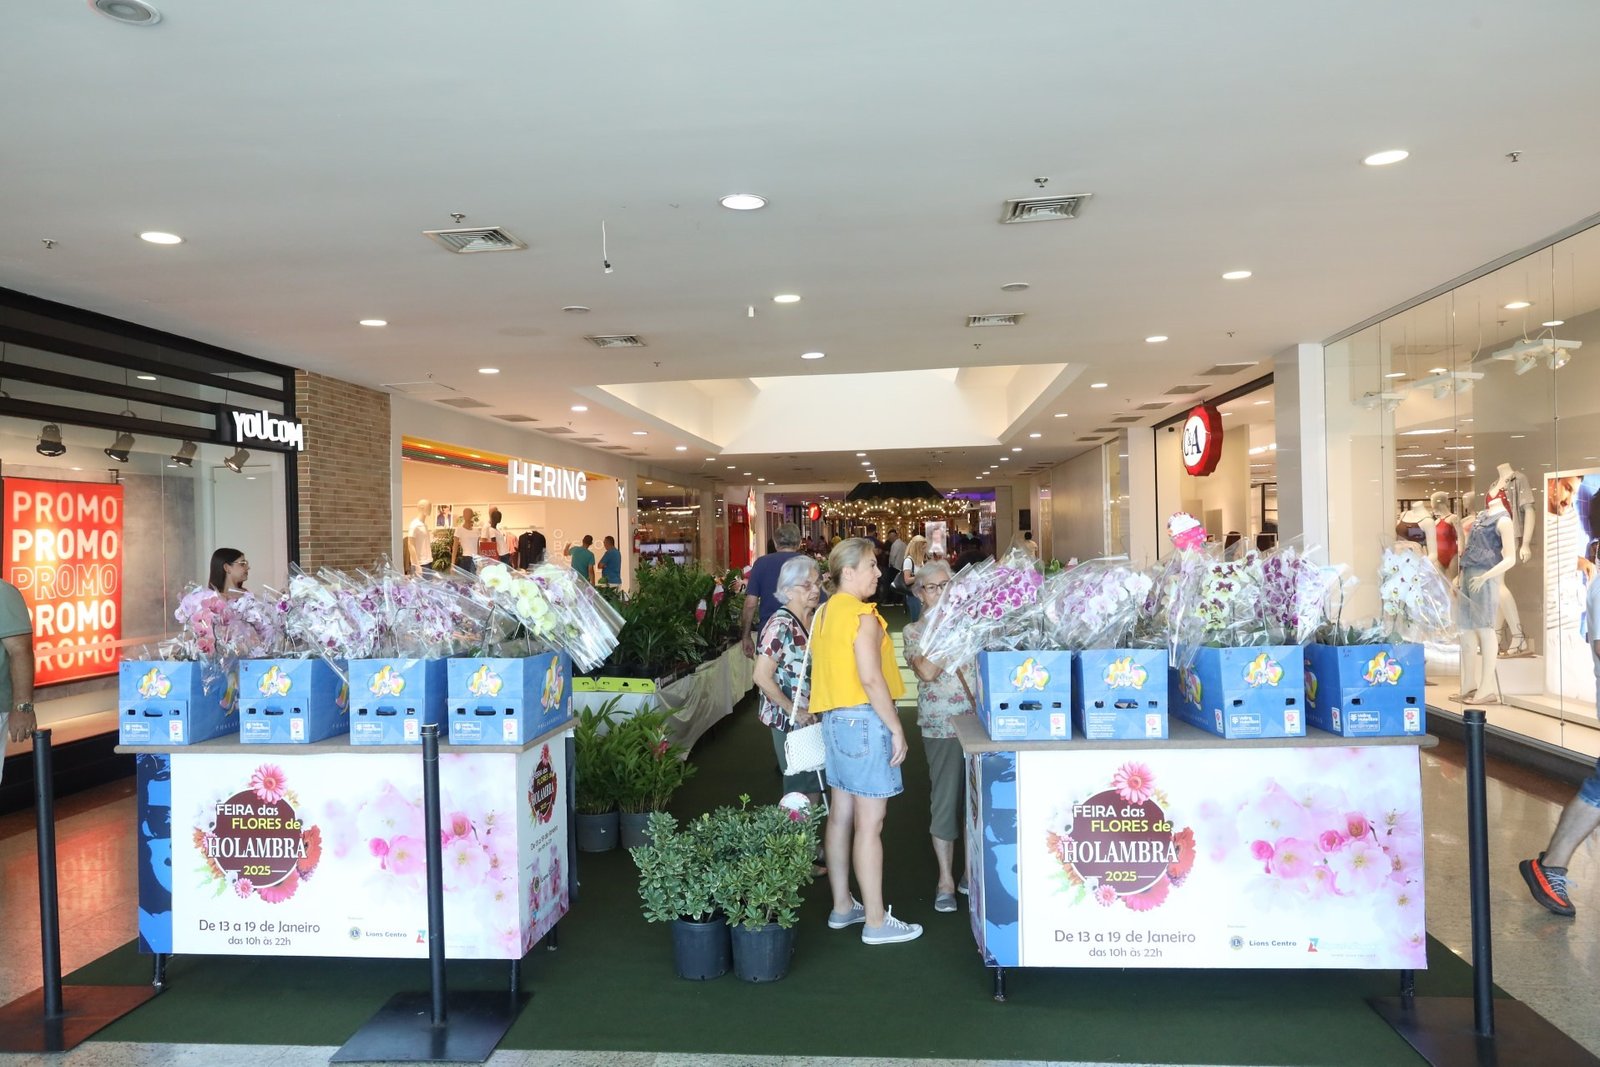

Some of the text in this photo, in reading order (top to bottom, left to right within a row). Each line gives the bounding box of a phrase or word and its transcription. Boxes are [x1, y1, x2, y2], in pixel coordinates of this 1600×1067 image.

[232, 410, 304, 451] YOUCOM
[512, 459, 587, 502] HERING
[12, 490, 118, 525] PROMO
[11, 528, 118, 562] PROMO
[10, 563, 118, 600] PROMO
[29, 598, 117, 638] ROMO
[35, 633, 116, 673] ROMO
[216, 803, 278, 816] FEIRA das
[1073, 805, 1145, 818] FEIRA das
[231, 818, 301, 830] FLORES de
[1091, 820, 1171, 832] FLORES de
[207, 837, 307, 858] HOLAMBRA
[1063, 841, 1179, 863] HOLAMBRA
[243, 865, 271, 876] 2025
[1105, 871, 1137, 882] 2025
[199, 919, 321, 933] De 13 a 19 de Janeiro
[227, 936, 291, 946] das 10h às 22h
[1054, 929, 1196, 944] De 13 a 19 de Janeiro
[1088, 947, 1163, 957] das 10h às 22h
